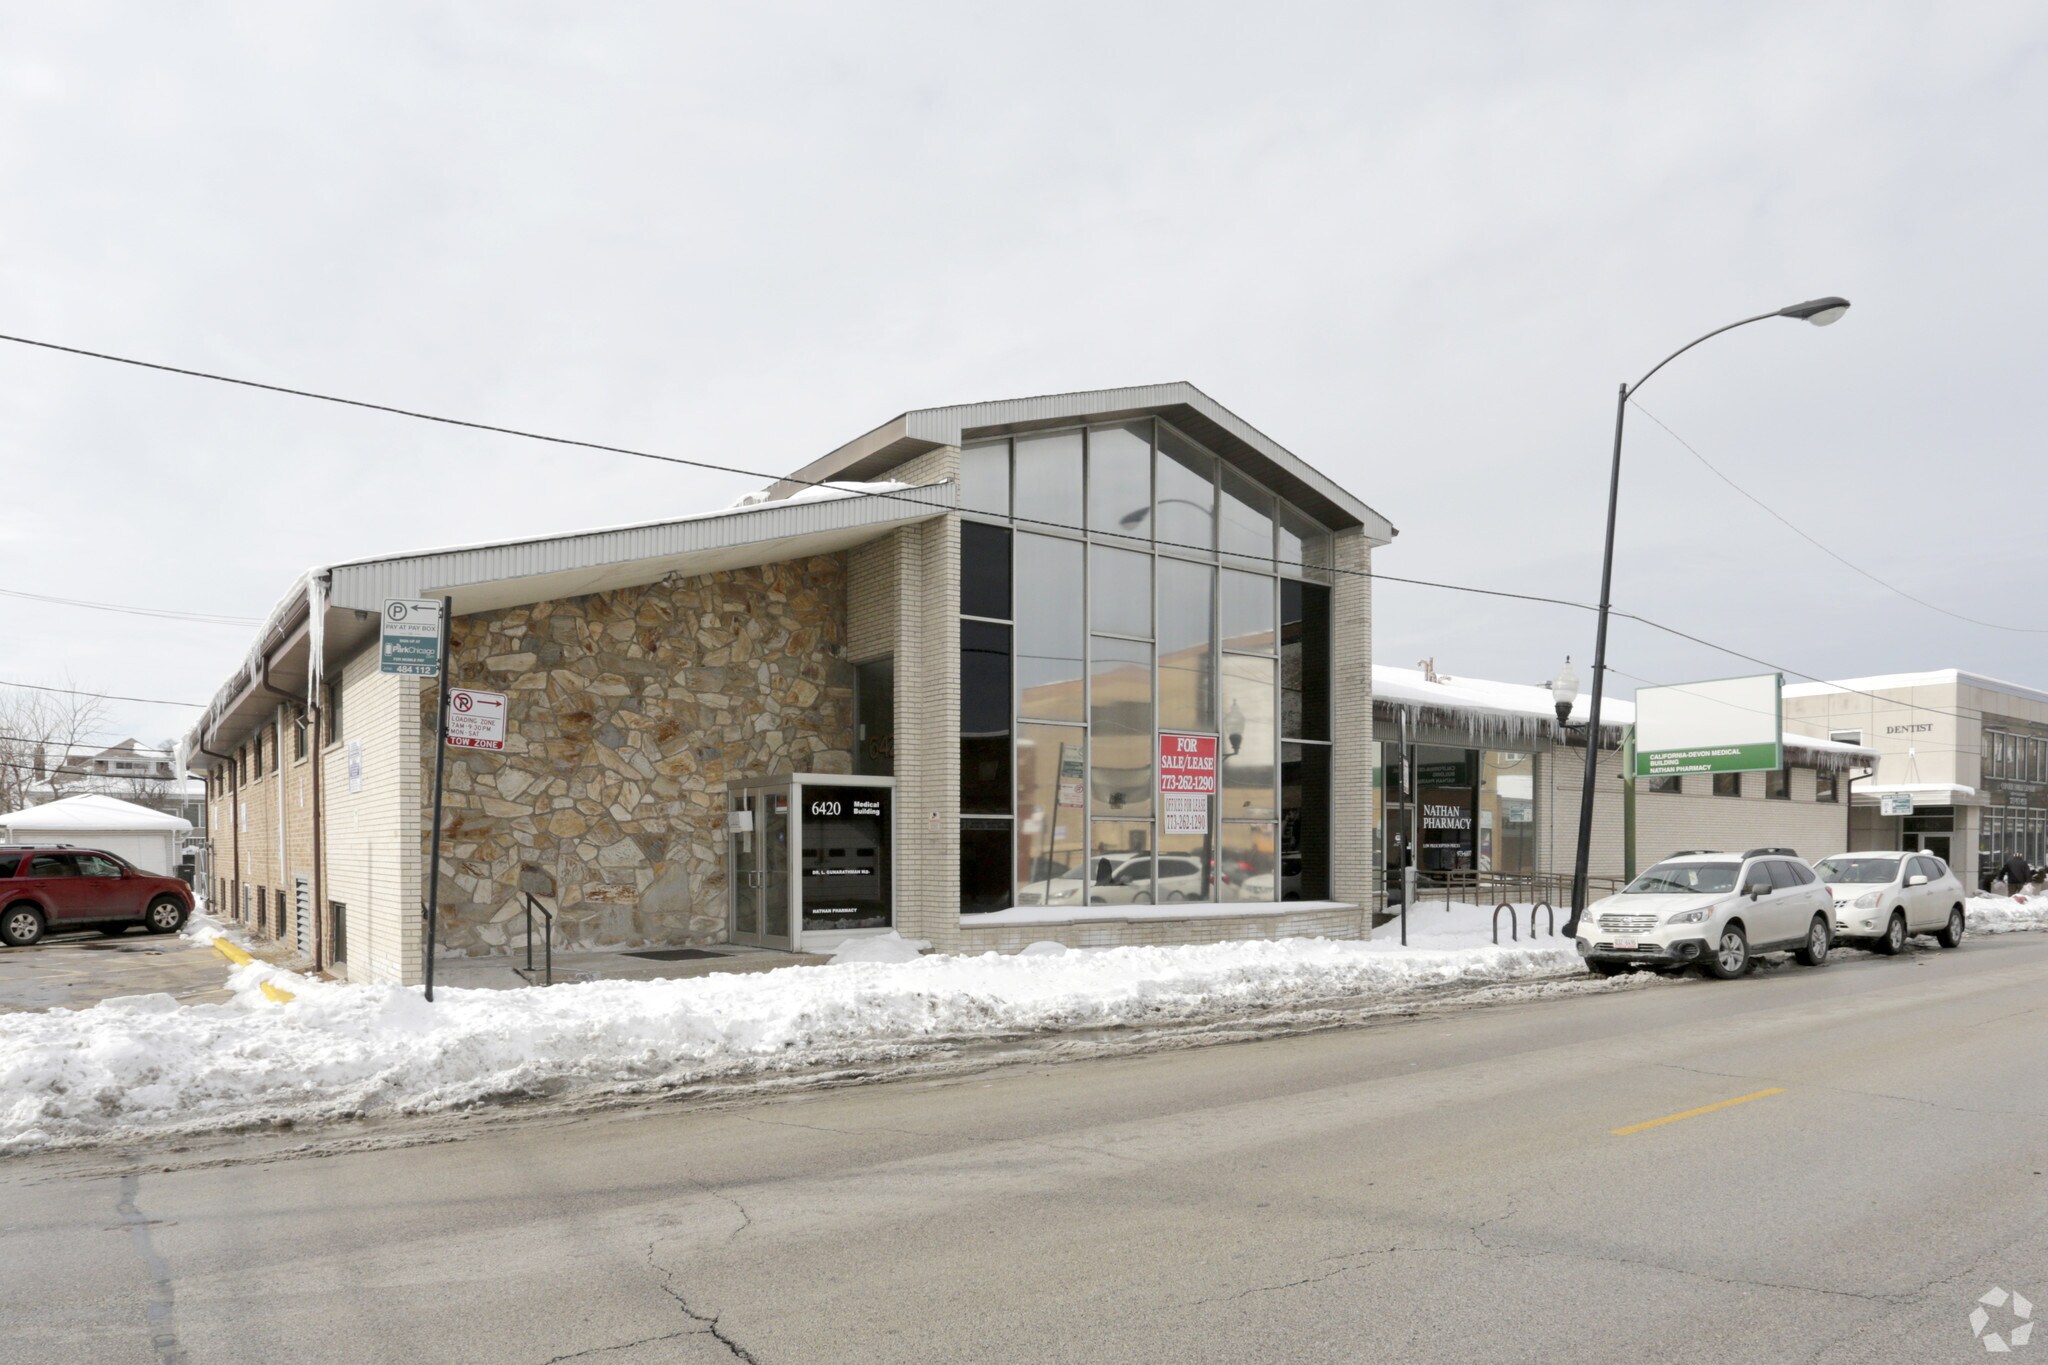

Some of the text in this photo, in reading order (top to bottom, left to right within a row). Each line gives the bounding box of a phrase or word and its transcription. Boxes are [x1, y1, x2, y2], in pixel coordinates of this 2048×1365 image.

[392, 645, 435, 656] ParkChicago
[396, 665, 412, 673] 484
[415, 666, 431, 675] 112
[452, 715, 496, 727] LOADING ZONE
[1886, 723, 1934, 734] DENTIST
[451, 737, 498, 749] TOW ZONE
[1176, 737, 1197, 752] FOR
[1649, 748, 1741, 760] CALIFORNIA-DEVON MEDICAL
[1161, 754, 1214, 772] SALE/LEASE
[1649, 759, 1680, 767] BUILDING
[1649, 764, 1712, 774] NATHAN PHARMACY
[1161, 774, 1214, 790] 773-262-1290
[811, 801, 842, 816] 6420
[853, 800, 880, 808] Medical
[853, 808, 880, 816] Building
[1423, 804, 1460, 817] NATHAN
[1166, 814, 1206, 830] 773-262-1290
[1423, 817, 1472, 830] PHARMACY
